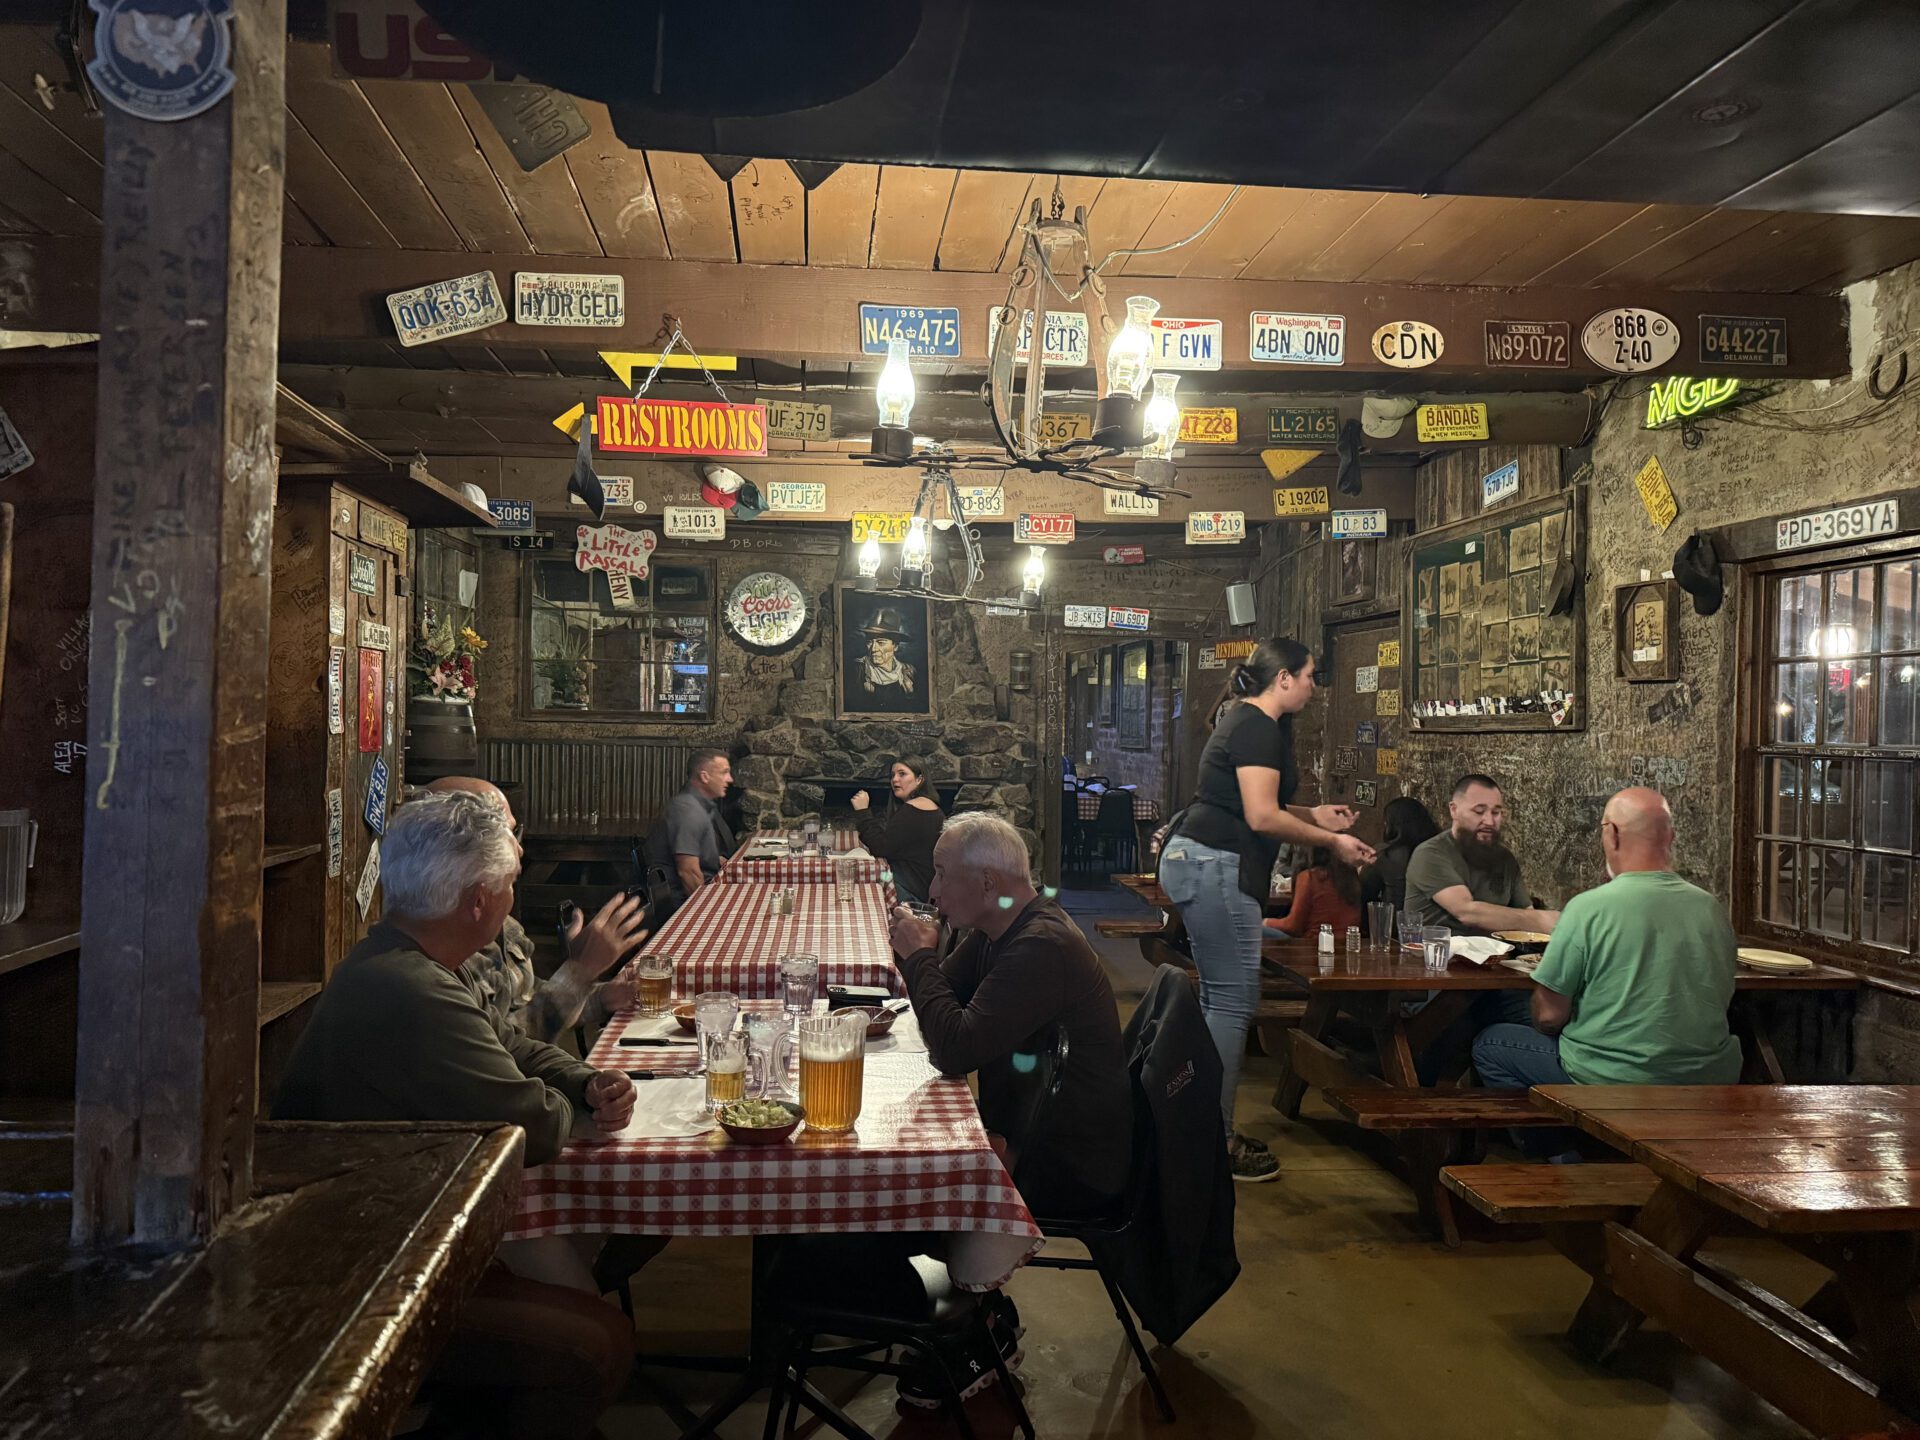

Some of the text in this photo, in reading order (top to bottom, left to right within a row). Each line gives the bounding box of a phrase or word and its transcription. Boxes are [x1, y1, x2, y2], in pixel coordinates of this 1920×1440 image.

[424, 281, 460, 298] OHIO
[543, 280, 597, 289] CALIFORNIA
[451, 282, 495, 317] 634
[520, 292, 618, 318] HYDR GED
[896, 309, 924, 318] 1969
[919, 319, 957, 346] 475
[1162, 321, 1185, 329] OHIO
[1276, 317, 1323, 330] Washington
[1614, 315, 1646, 337] 868
[910, 345, 936, 354] ARIO
[1179, 334, 1212, 359] GVN
[1256, 329, 1292, 354] 4BN
[1380, 333, 1437, 360] CDN
[1705, 327, 1780, 354] 644227
[1615, 340, 1652, 363] Z-40
[1646, 376, 1739, 428] MGD
[1204, 417, 1233, 434] 228
[1426, 408, 1479, 426] BANDAG
[601, 402, 764, 451] RESTROOMS
[1110, 494, 1154, 509] WALLIS
[1290, 490, 1326, 506] 19202
[606, 525, 626, 538] THE
[1024, 518, 1073, 532] DCY177
[1193, 519, 1241, 532] RWB 219
[578, 551, 648, 578] RASCALS
[741, 593, 792, 614] Coors
[749, 611, 790, 628] LIGHT
[1215, 640, 1255, 659] RESTROOMS
